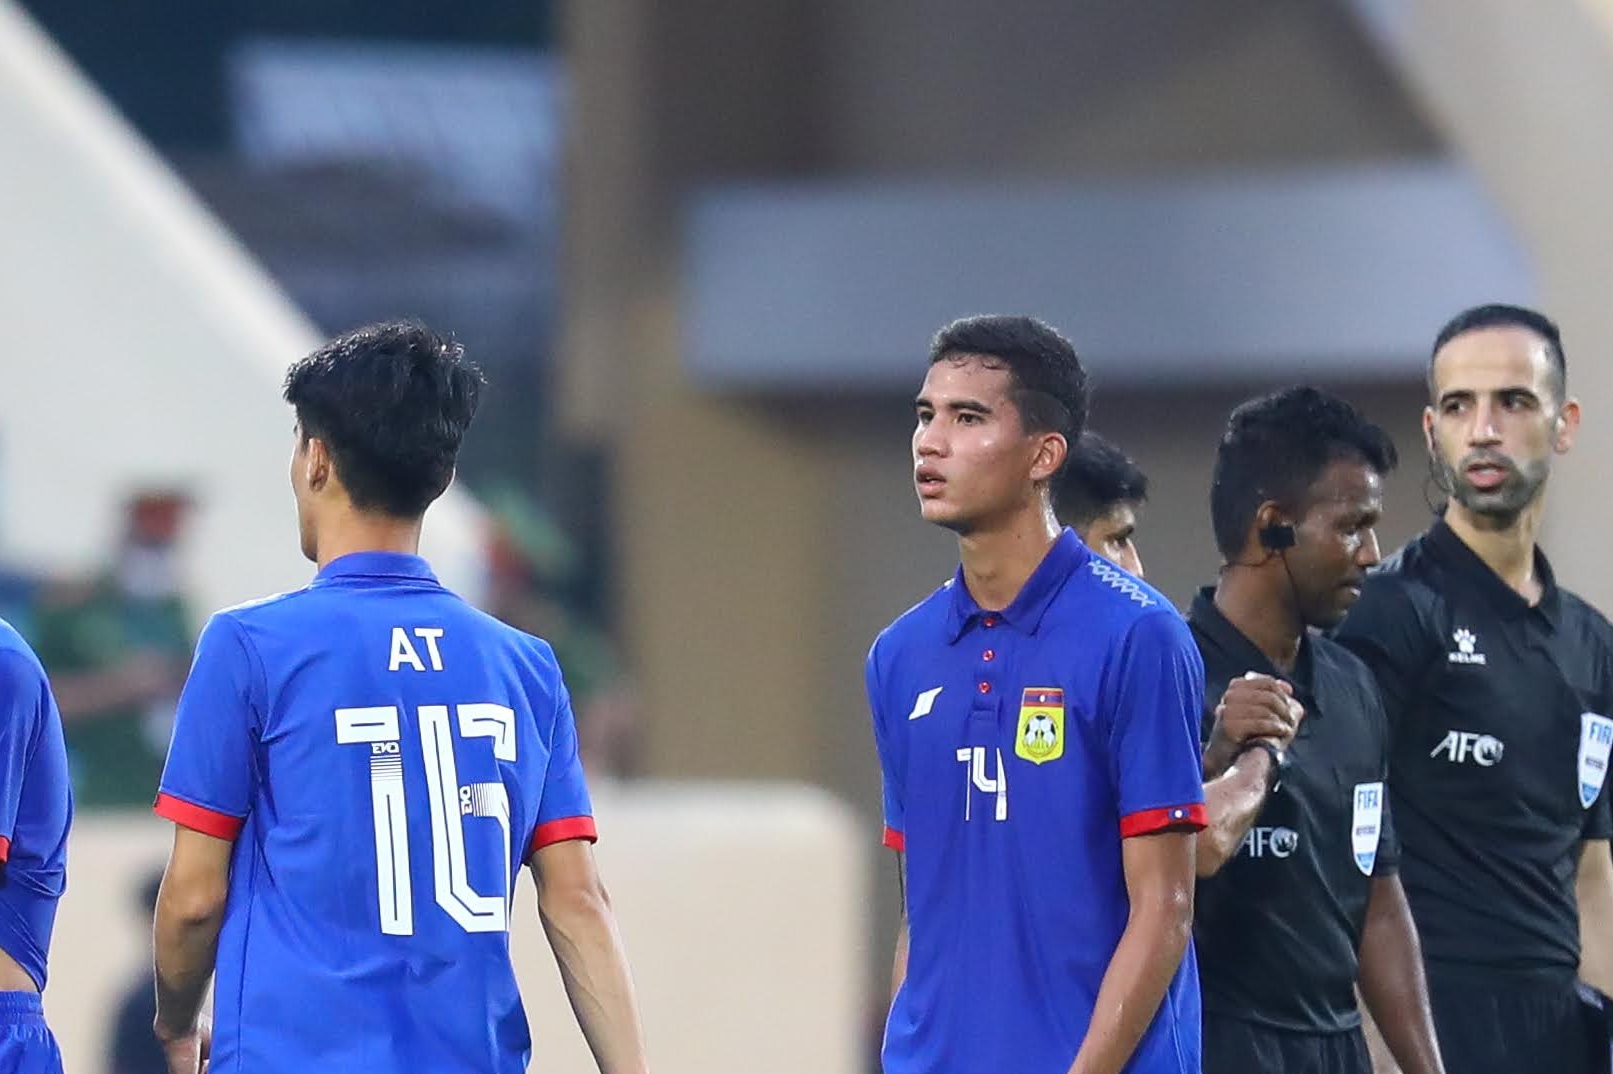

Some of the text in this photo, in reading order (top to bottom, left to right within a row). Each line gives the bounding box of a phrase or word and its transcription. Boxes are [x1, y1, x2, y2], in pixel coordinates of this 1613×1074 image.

[388, 627, 446, 672] AT
[1430, 730, 1504, 767] AFC
[956, 746, 1007, 821] 14
[334, 703, 517, 936] 16
